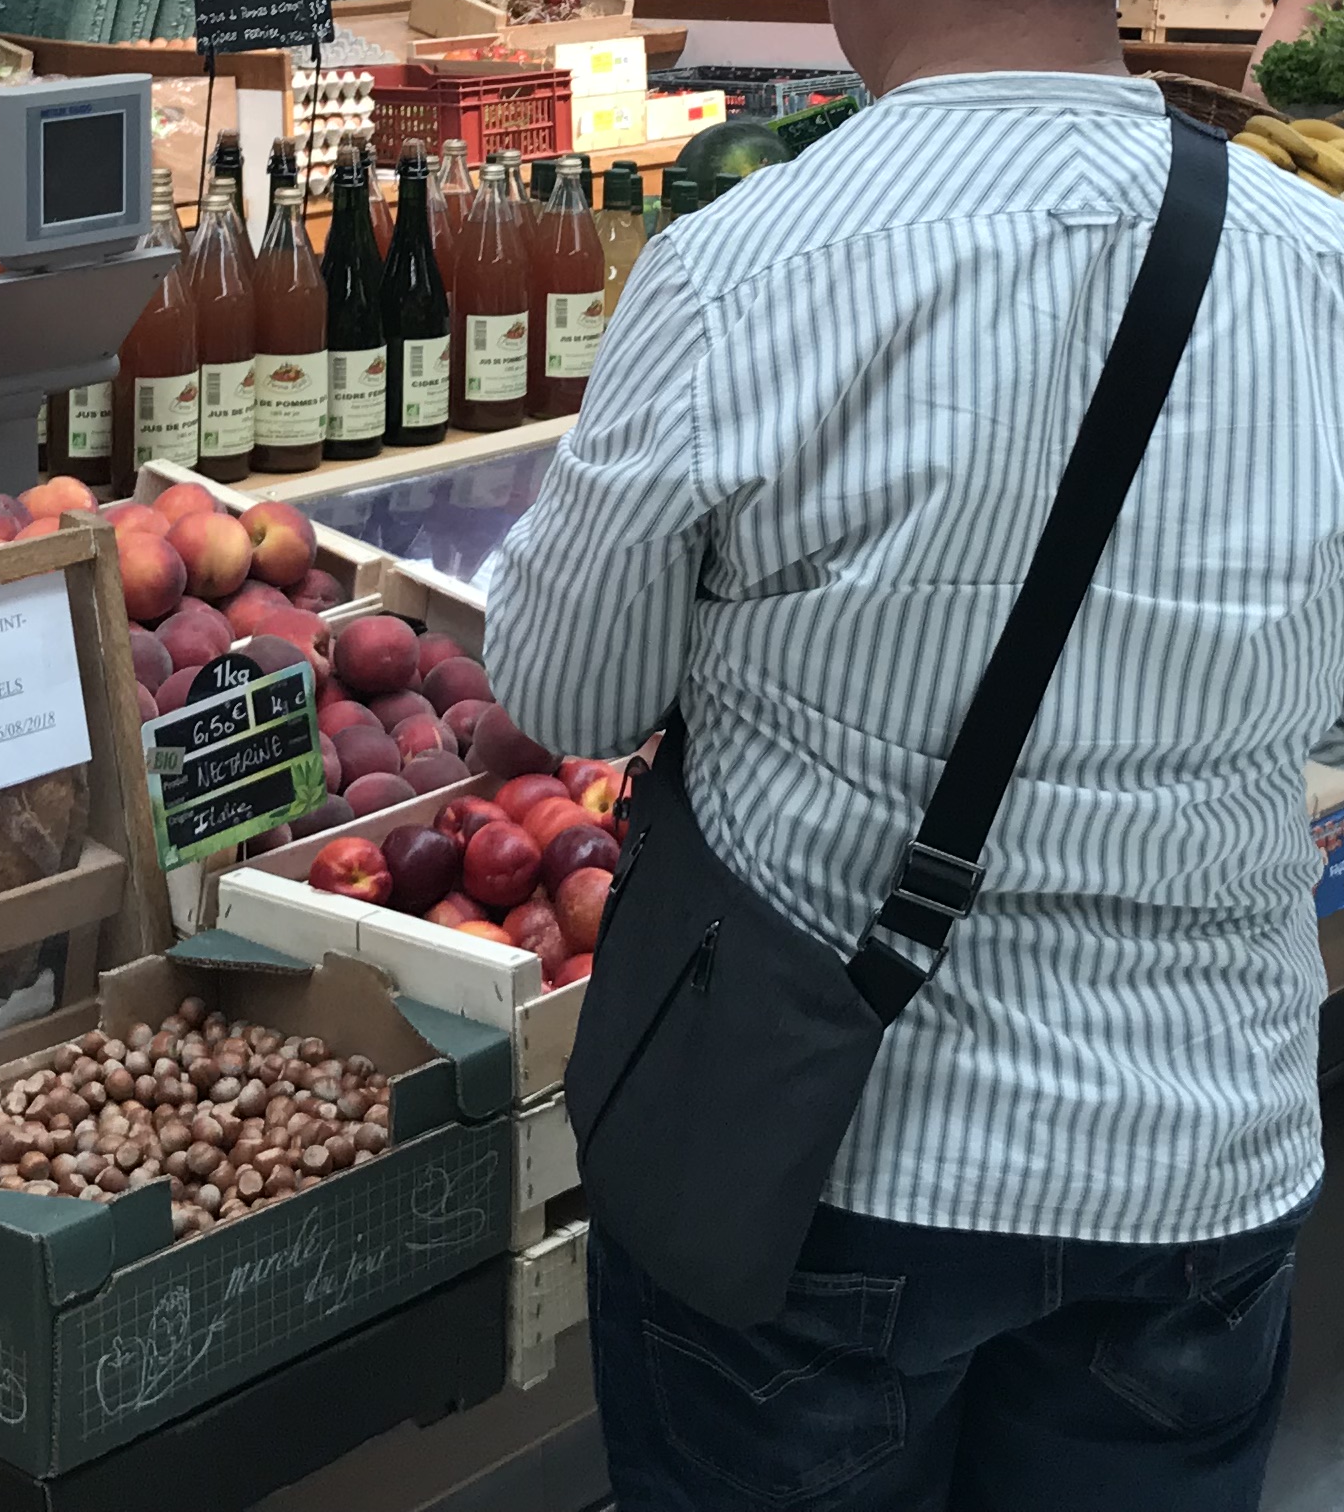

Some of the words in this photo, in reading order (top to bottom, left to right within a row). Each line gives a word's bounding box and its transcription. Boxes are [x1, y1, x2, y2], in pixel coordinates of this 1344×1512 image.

[411, 378, 439, 388] CIDRE
[334, 391, 366, 401] CIDRE
[275, 398, 318, 408] POMMES
[208, 409, 229, 419] JUS
[140, 424, 162, 433] JUS
[212, 659, 251, 688] 1kg
[156, 752, 178, 770] BIO
